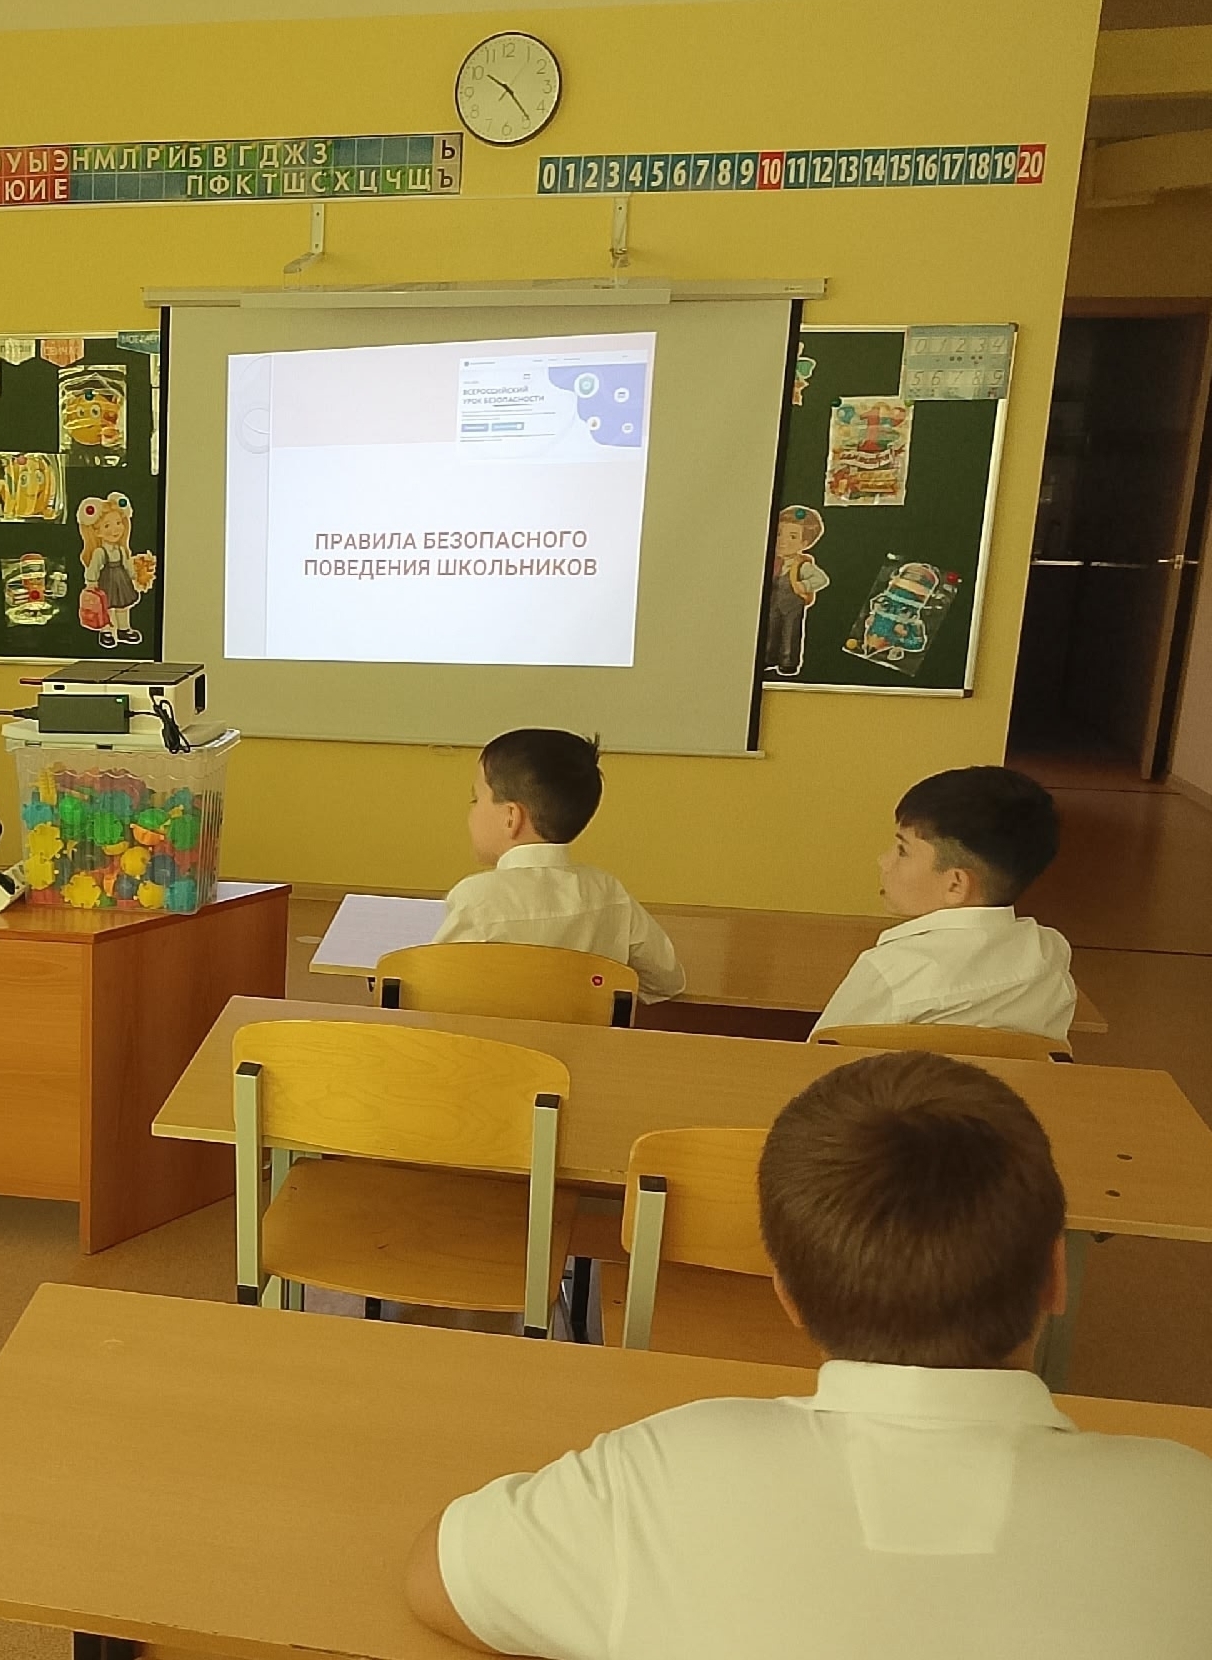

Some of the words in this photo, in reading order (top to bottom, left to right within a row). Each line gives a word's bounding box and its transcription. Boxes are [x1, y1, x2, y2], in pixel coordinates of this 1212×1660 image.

[485, 49, 495, 64] 11
[502, 43, 515, 58] 12
[472, 65, 484, 80] 10
[536, 59, 547, 74] 2
[464, 86, 474, 101] 9
[542, 80, 552, 94] 3
[470, 105, 479, 119] 8
[536, 100, 545, 114] 4
[486, 119, 492, 132] 7
[502, 122, 512, 136] 6
[543, 164, 556, 189] 0
[566, 164, 575, 188] 1
[585, 162, 598, 188] 2
[607, 162, 620, 188] 3
[629, 162, 642, 187] 4
[651, 162, 664, 186] 5
[673, 160, 686, 186] 6
[696, 160, 709, 186] 7
[717, 159, 731, 186] 8
[740, 159, 754, 185] 9
[762, 159, 781, 184] 10
[787, 158, 806, 183] 11
[813, 157, 833, 182] 12
[839, 156, 858, 182] 13
[864, 155, 885, 181] 14
[890, 155, 911, 181] 15
[916, 154, 938, 181] 16
[942, 154, 964, 180] 17
[968, 153, 990, 179] 18
[994, 152, 1016, 179] 19
[1018, 151, 1042, 178] 20
[916, 339, 927, 354] 0
[956, 338, 965, 352] 2
[975, 339, 986, 352] 3
[911, 371, 924, 385] 5
[932, 370, 944, 385] 6
[972, 371, 982, 385] 8
[990, 370, 1002, 385] 9
[316, 533, 417, 550] ПРАВИЛА
[424, 530, 588, 549] БЕЗОПАСНОГО
[304, 559, 430, 580] ПОВЕДЕНИЯ
[438, 558, 597, 576] ШКОЛЬНИКОВ
